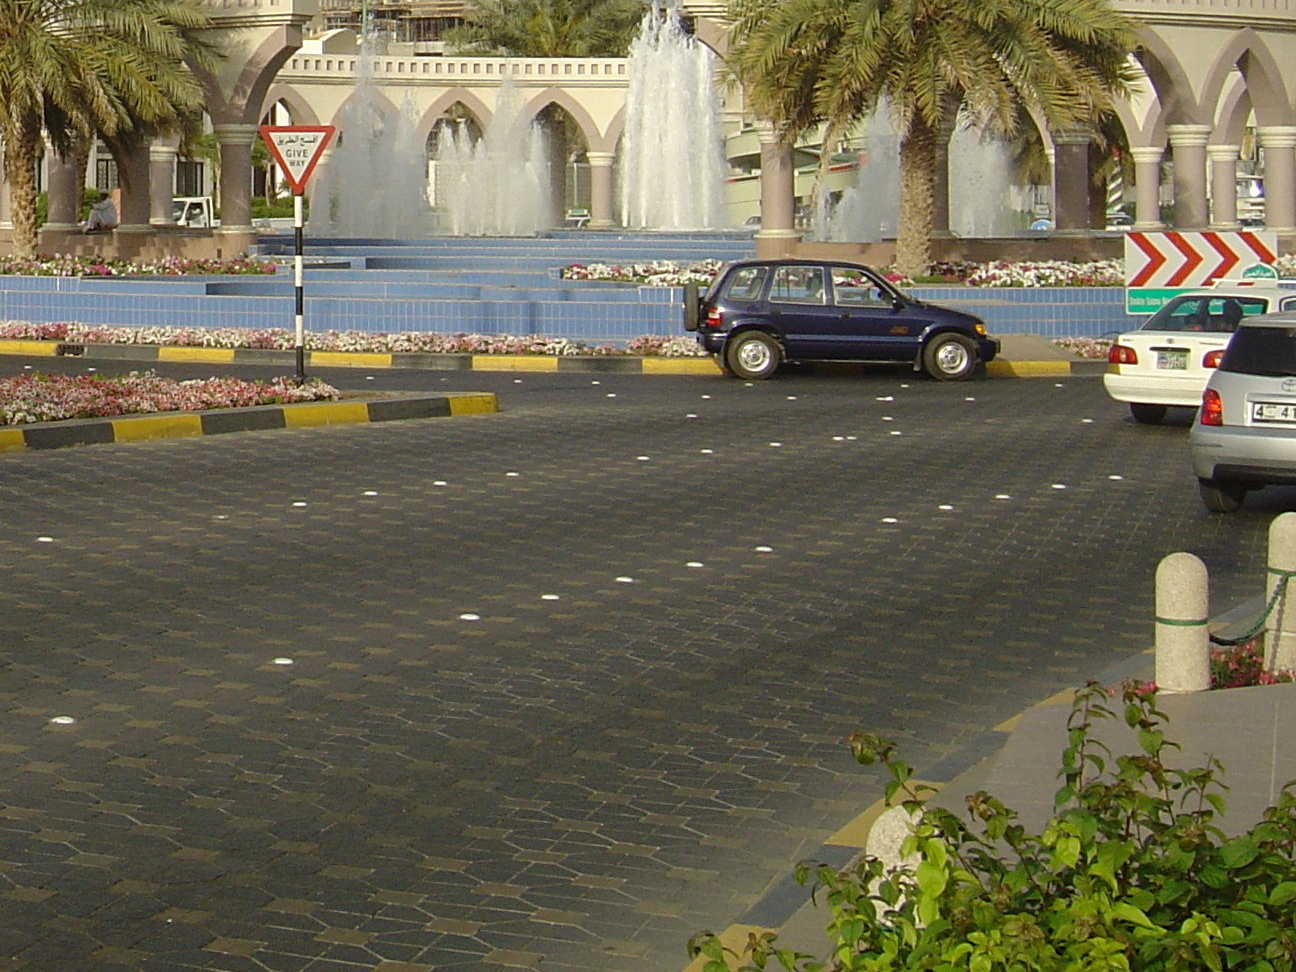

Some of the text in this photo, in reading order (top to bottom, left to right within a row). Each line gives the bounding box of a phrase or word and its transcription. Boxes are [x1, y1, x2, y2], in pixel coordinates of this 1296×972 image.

[277, 135, 299, 146] الطريق
[286, 149, 308, 158] GIVE
[1256, 405, 1264, 418] 4
